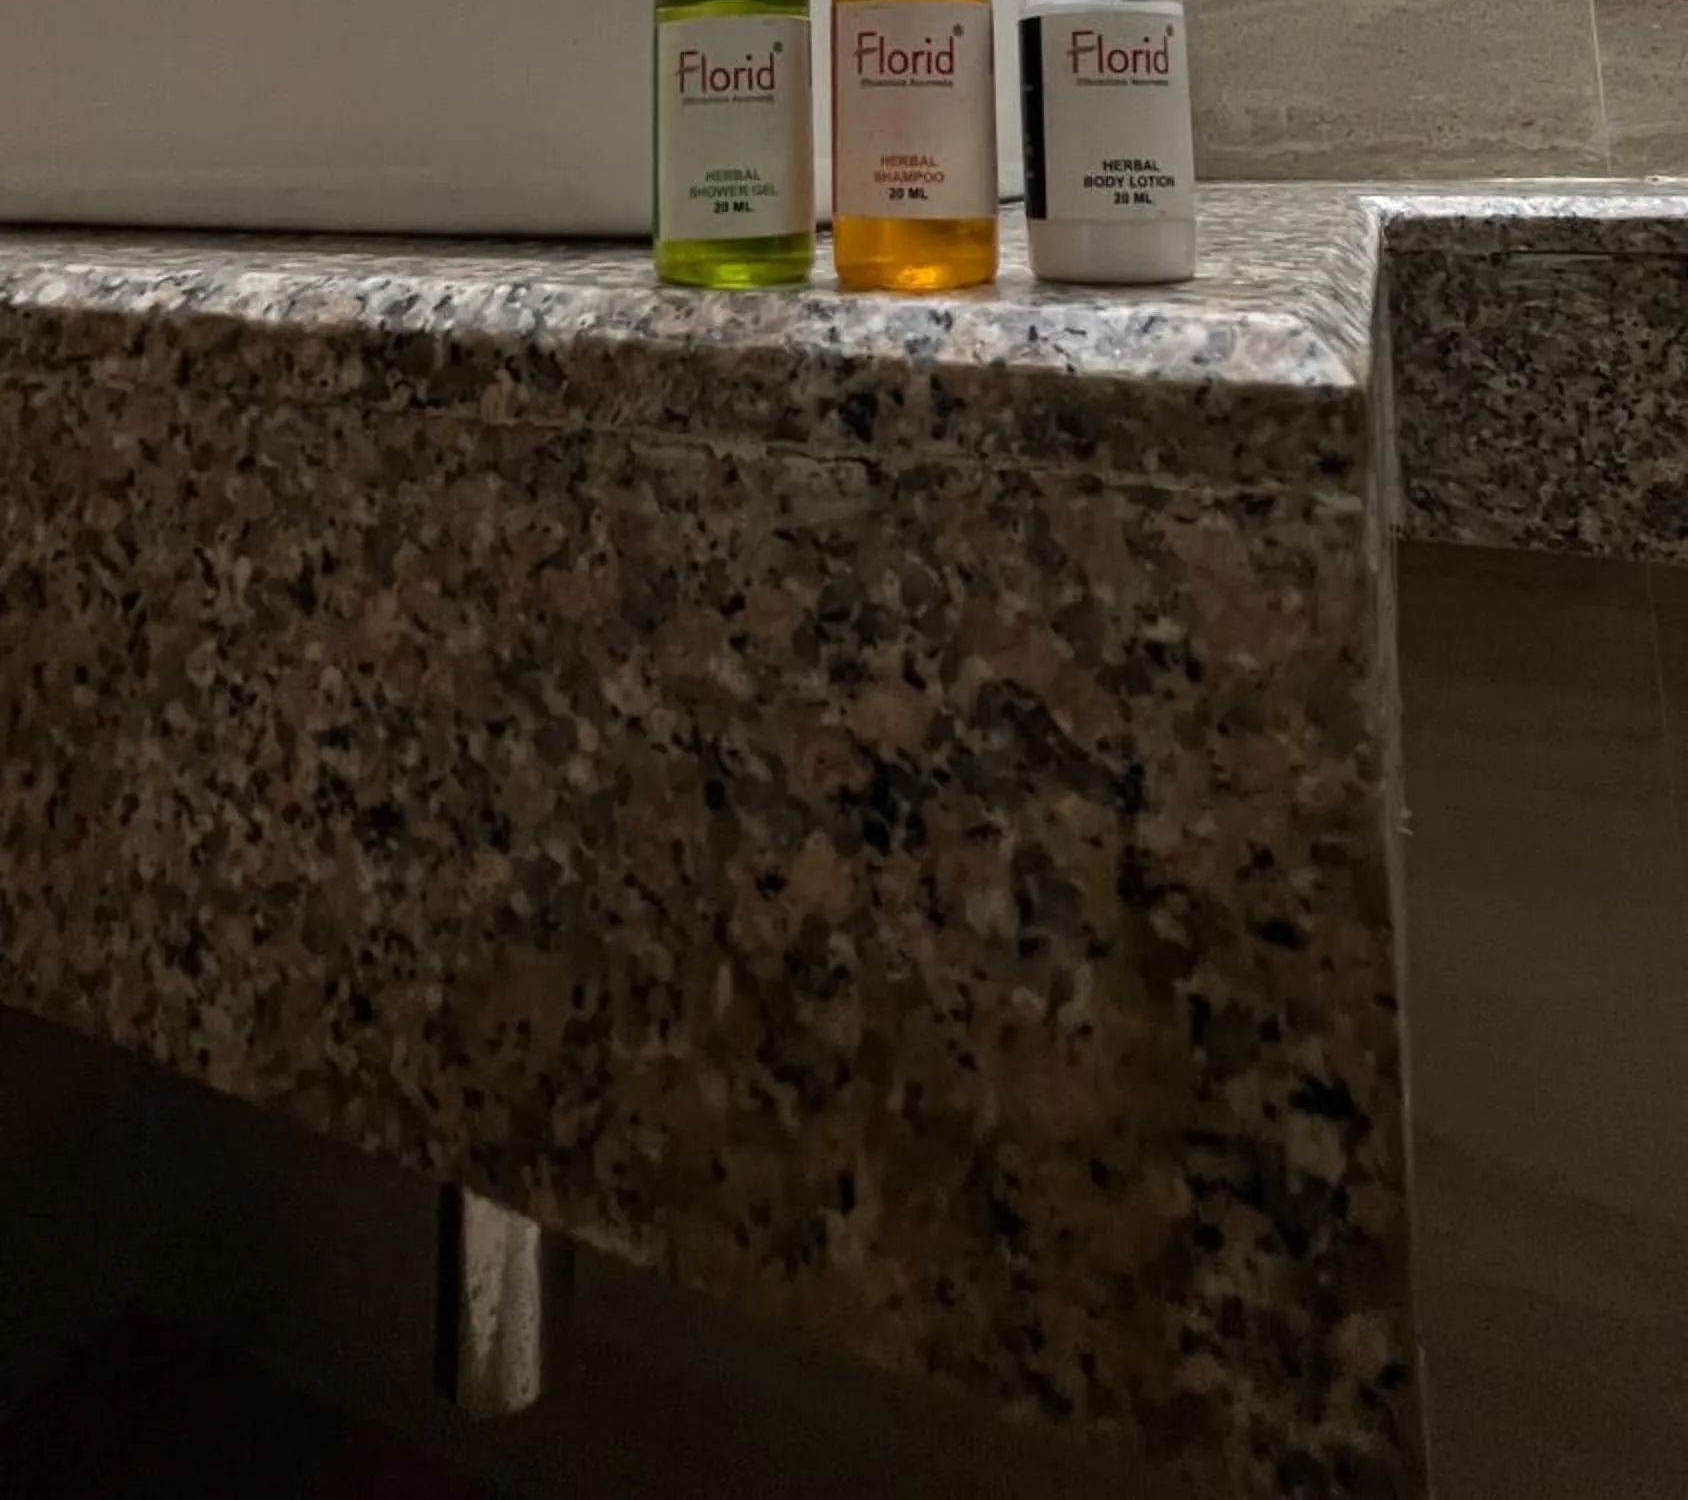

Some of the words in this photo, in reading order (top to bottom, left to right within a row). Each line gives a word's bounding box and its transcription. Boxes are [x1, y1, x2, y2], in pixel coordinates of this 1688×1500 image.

[854, 31, 955, 76] Florid
[1068, 30, 1169, 75] Florid
[675, 50, 776, 93] Florid
[880, 155, 937, 168] HERBAL
[1102, 159, 1159, 172] HERBAL
[705, 168, 761, 182] HERBAL
[874, 171, 944, 185] SHAMPOO
[1083, 175, 1124, 189] BODY
[1129, 174, 1175, 188] LOTION
[689, 184, 750, 199] SHOWER
[752, 182, 777, 197] GEL
[888, 187, 905, 200] 20
[908, 186, 928, 200] ML
[1113, 192, 1129, 205] 20
[713, 200, 730, 214] 20
